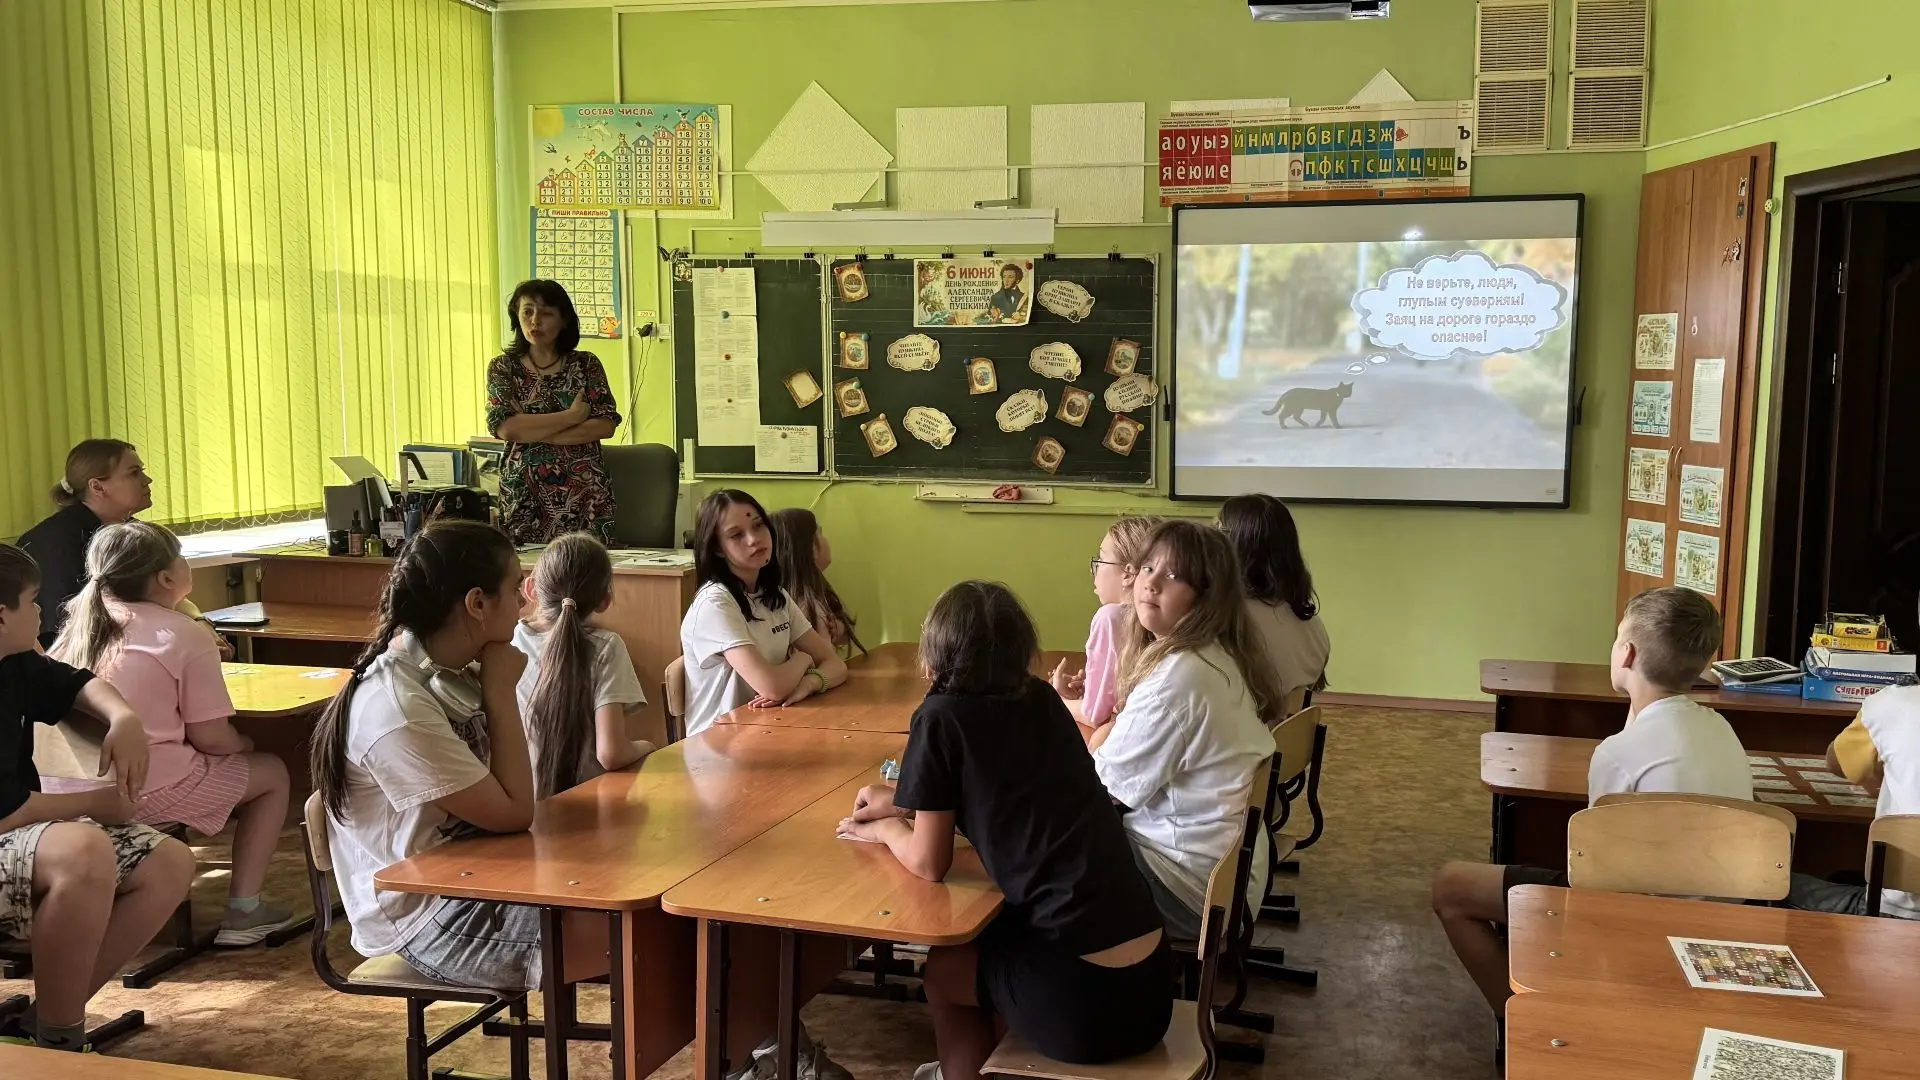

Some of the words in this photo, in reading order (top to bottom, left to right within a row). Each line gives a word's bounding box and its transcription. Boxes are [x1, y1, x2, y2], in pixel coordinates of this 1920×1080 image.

[947, 265, 956, 279] 6
[960, 267, 995, 279] ИЮНЯ
[1407, 277, 1423, 288] Не
[1427, 278, 1474, 290] верьте,
[1478, 278, 1517, 290] люди,
[1398, 296, 1447, 309] глупым
[1386, 312, 1416, 326] Заяц
[1420, 315, 1434, 325] на
[1436, 314, 1481, 327] дороге
[1485, 314, 1536, 326] гораздо
[1432, 330, 1487, 343] опаснее!
